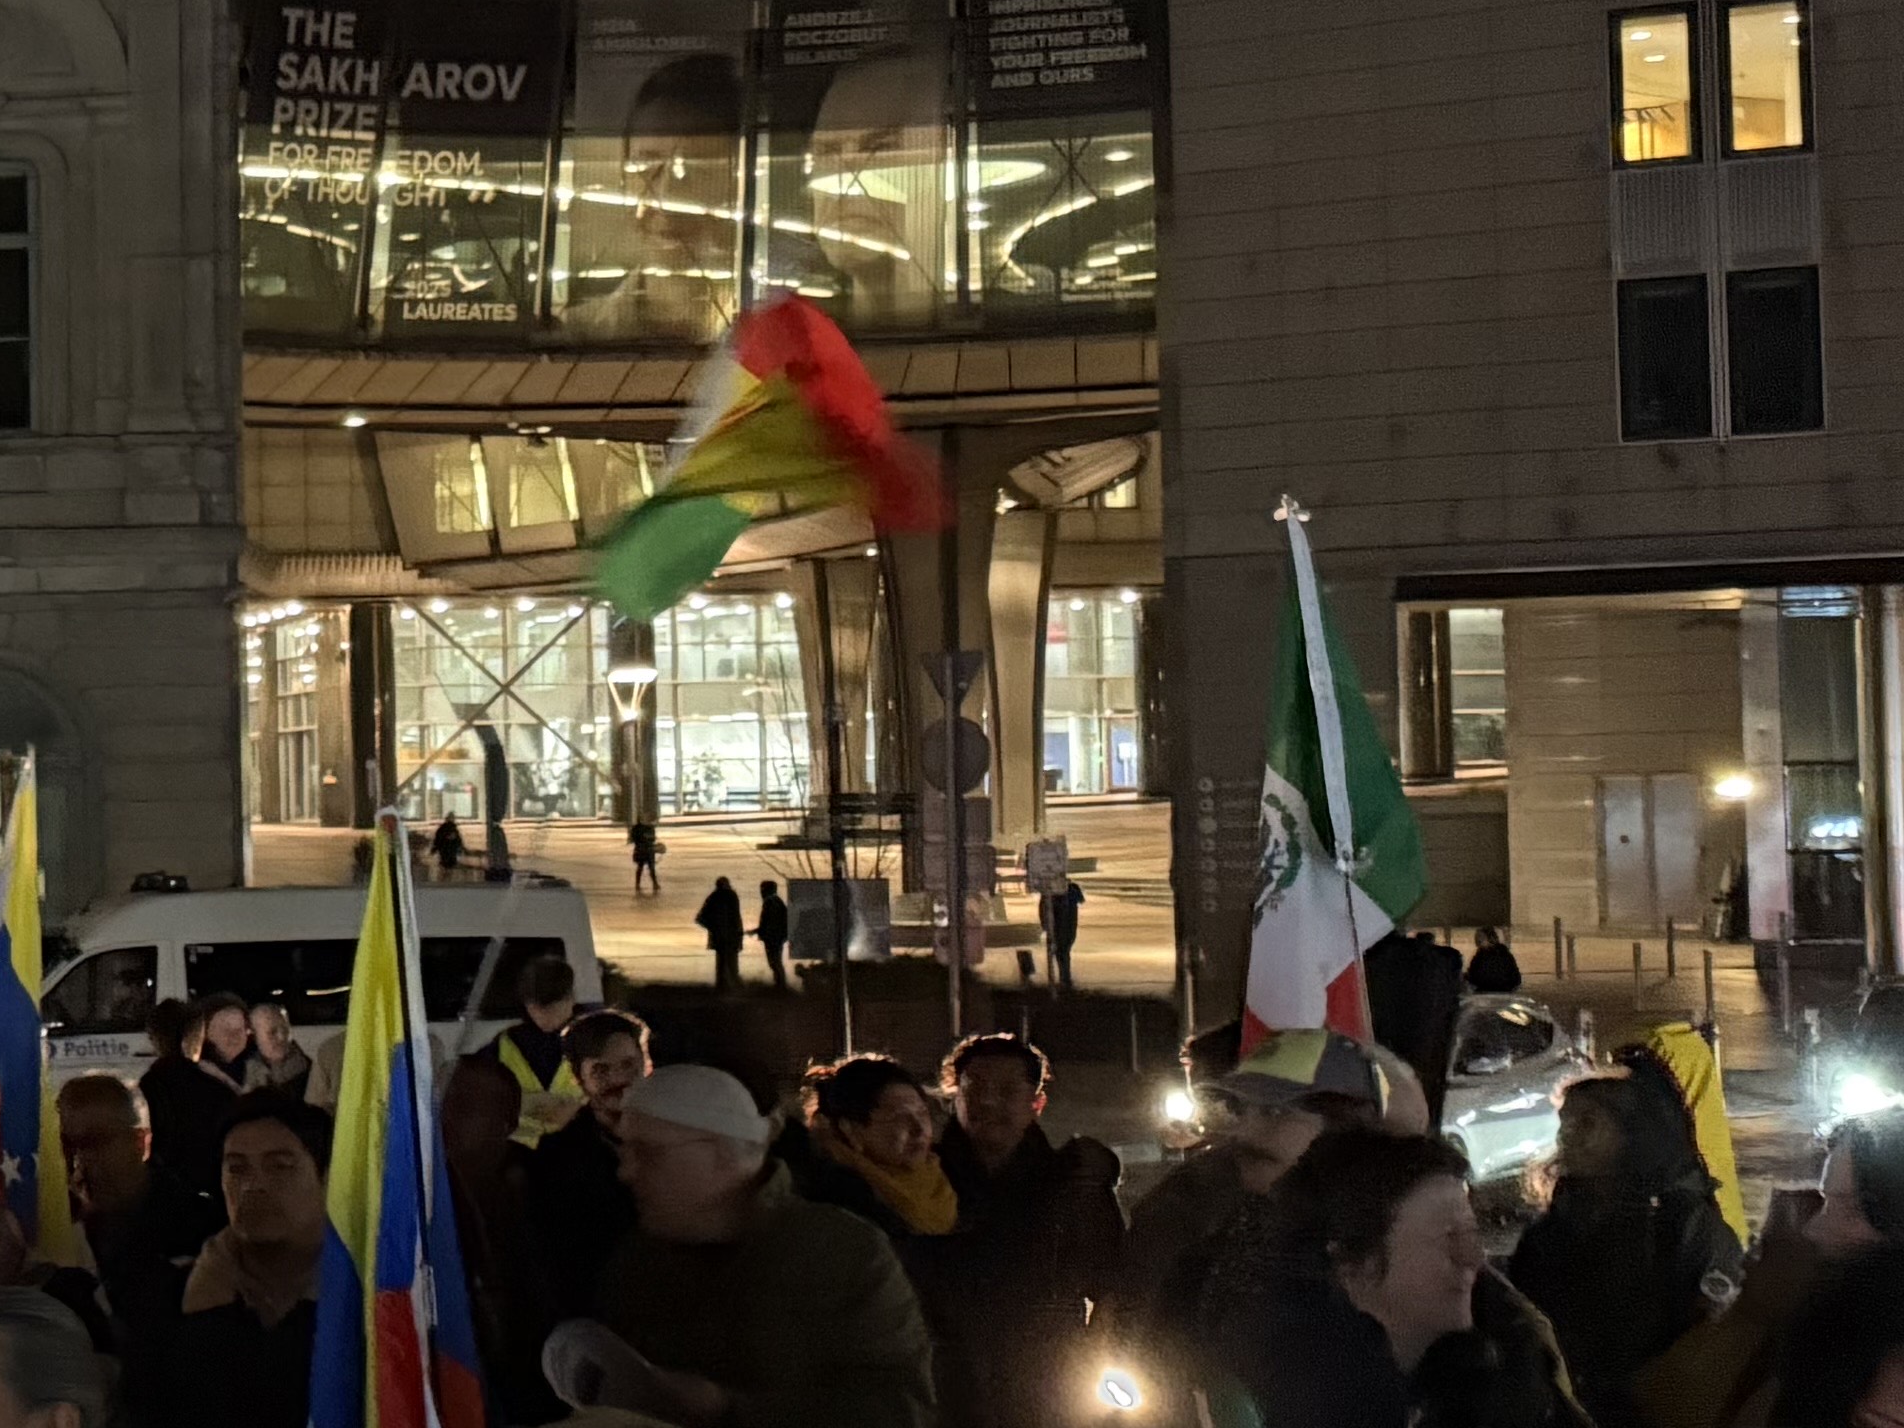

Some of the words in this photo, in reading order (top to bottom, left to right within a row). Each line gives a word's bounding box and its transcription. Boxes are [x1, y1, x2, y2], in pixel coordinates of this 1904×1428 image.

[282, 7, 357, 50] THE
[989, 8, 1125, 33] JOURNALISTS
[989, 31, 1084, 51] FIGHTING
[1088, 26, 1130, 44] FOR
[990, 51, 1044, 70] YOUR
[1049, 42, 1148, 66] FREEDOM
[991, 71, 1035, 89] AND
[1039, 66, 1095, 85] OURS
[272, 98, 376, 141] PRIZE
[268, 142, 318, 170] FOR
[402, 302, 518, 321] LAUREATES
[64, 1039, 130, 1057] Politie
